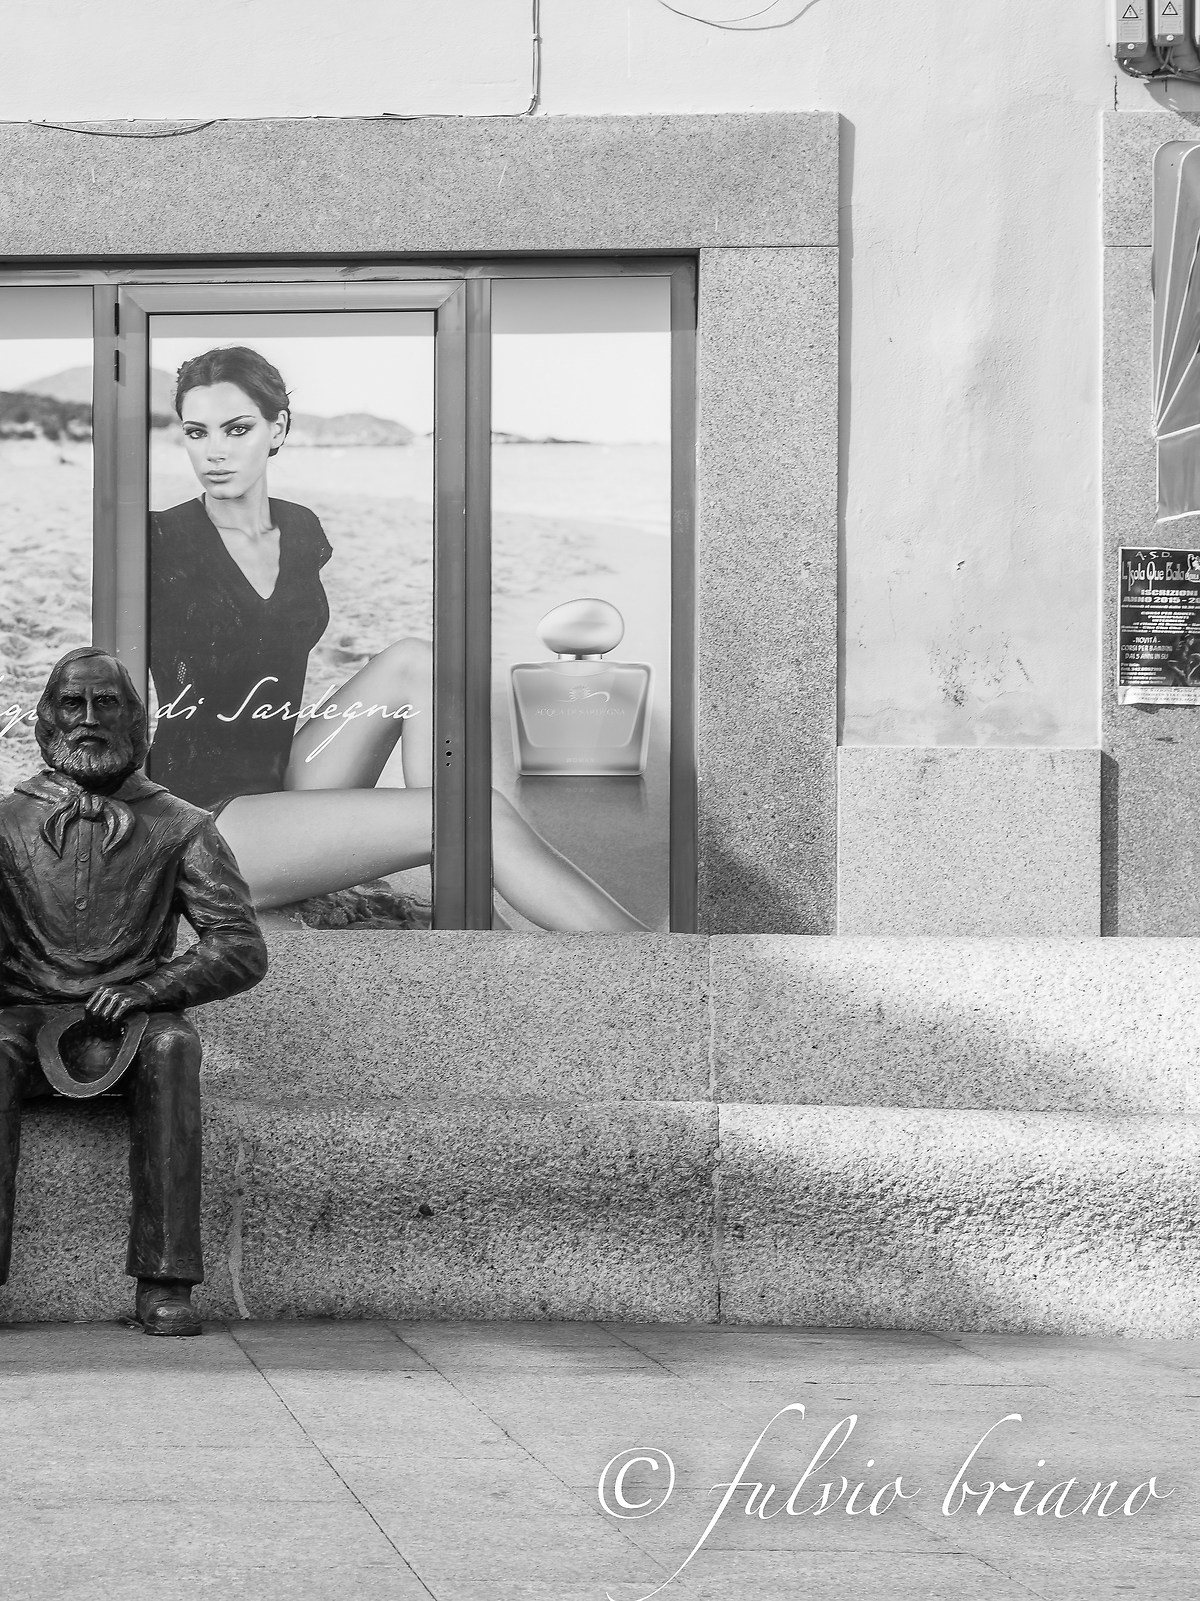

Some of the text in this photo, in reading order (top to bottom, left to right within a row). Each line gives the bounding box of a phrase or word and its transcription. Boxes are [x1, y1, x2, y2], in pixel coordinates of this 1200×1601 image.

[1140, 589, 1199, 597] ISCRIZIONI
[1153, 596, 1181, 604] 2015
[154, 683, 205, 720] di
[216, 676, 422, 763] Sardegna
